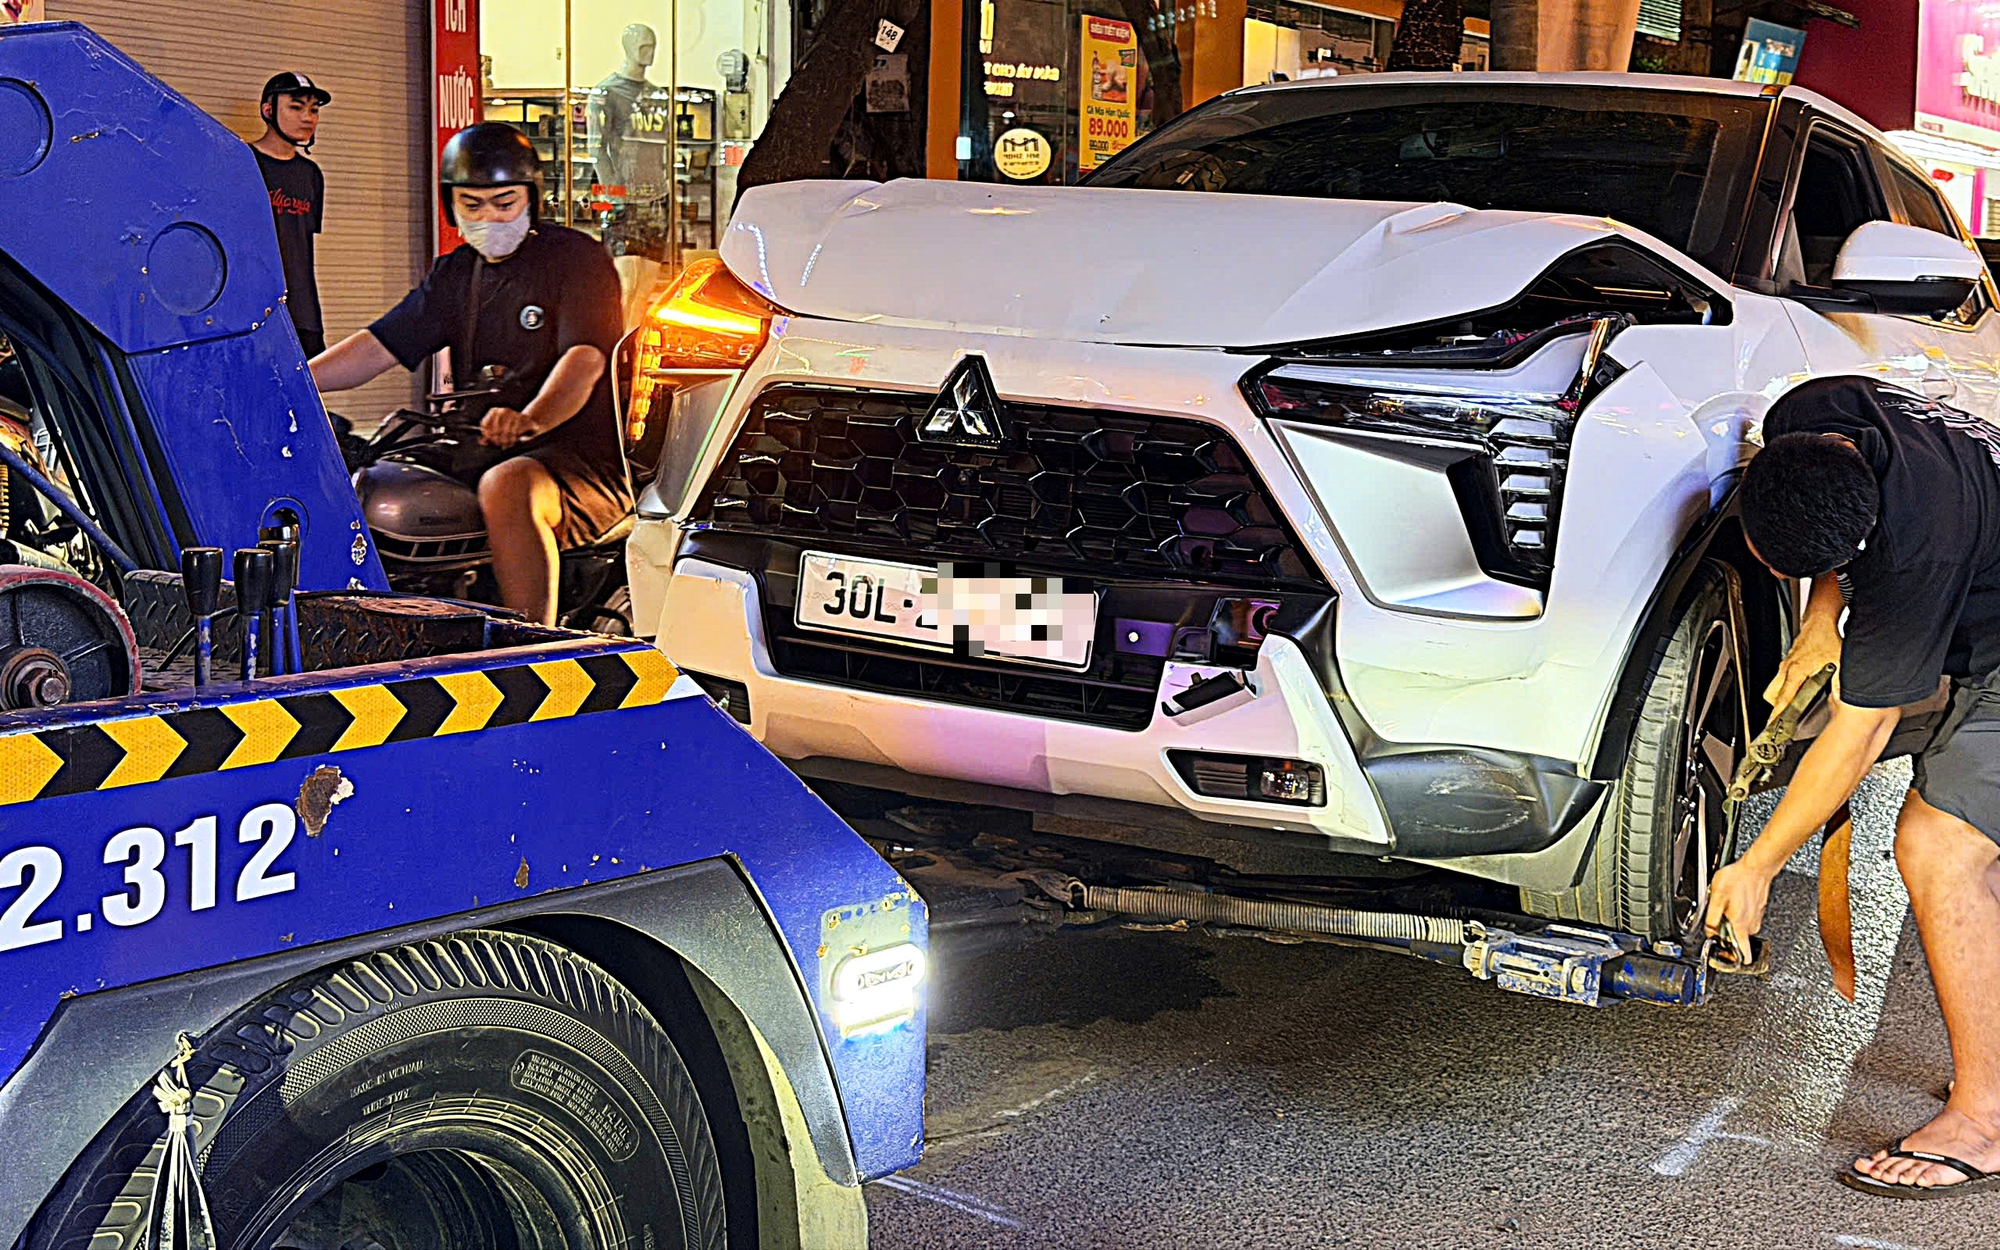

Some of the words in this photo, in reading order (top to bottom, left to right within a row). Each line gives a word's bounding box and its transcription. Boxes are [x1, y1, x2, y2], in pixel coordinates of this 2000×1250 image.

[881, 25, 898, 41] 148
[439, 65, 474, 127] NƯỚC
[1089, 118, 1128, 138] 89.000
